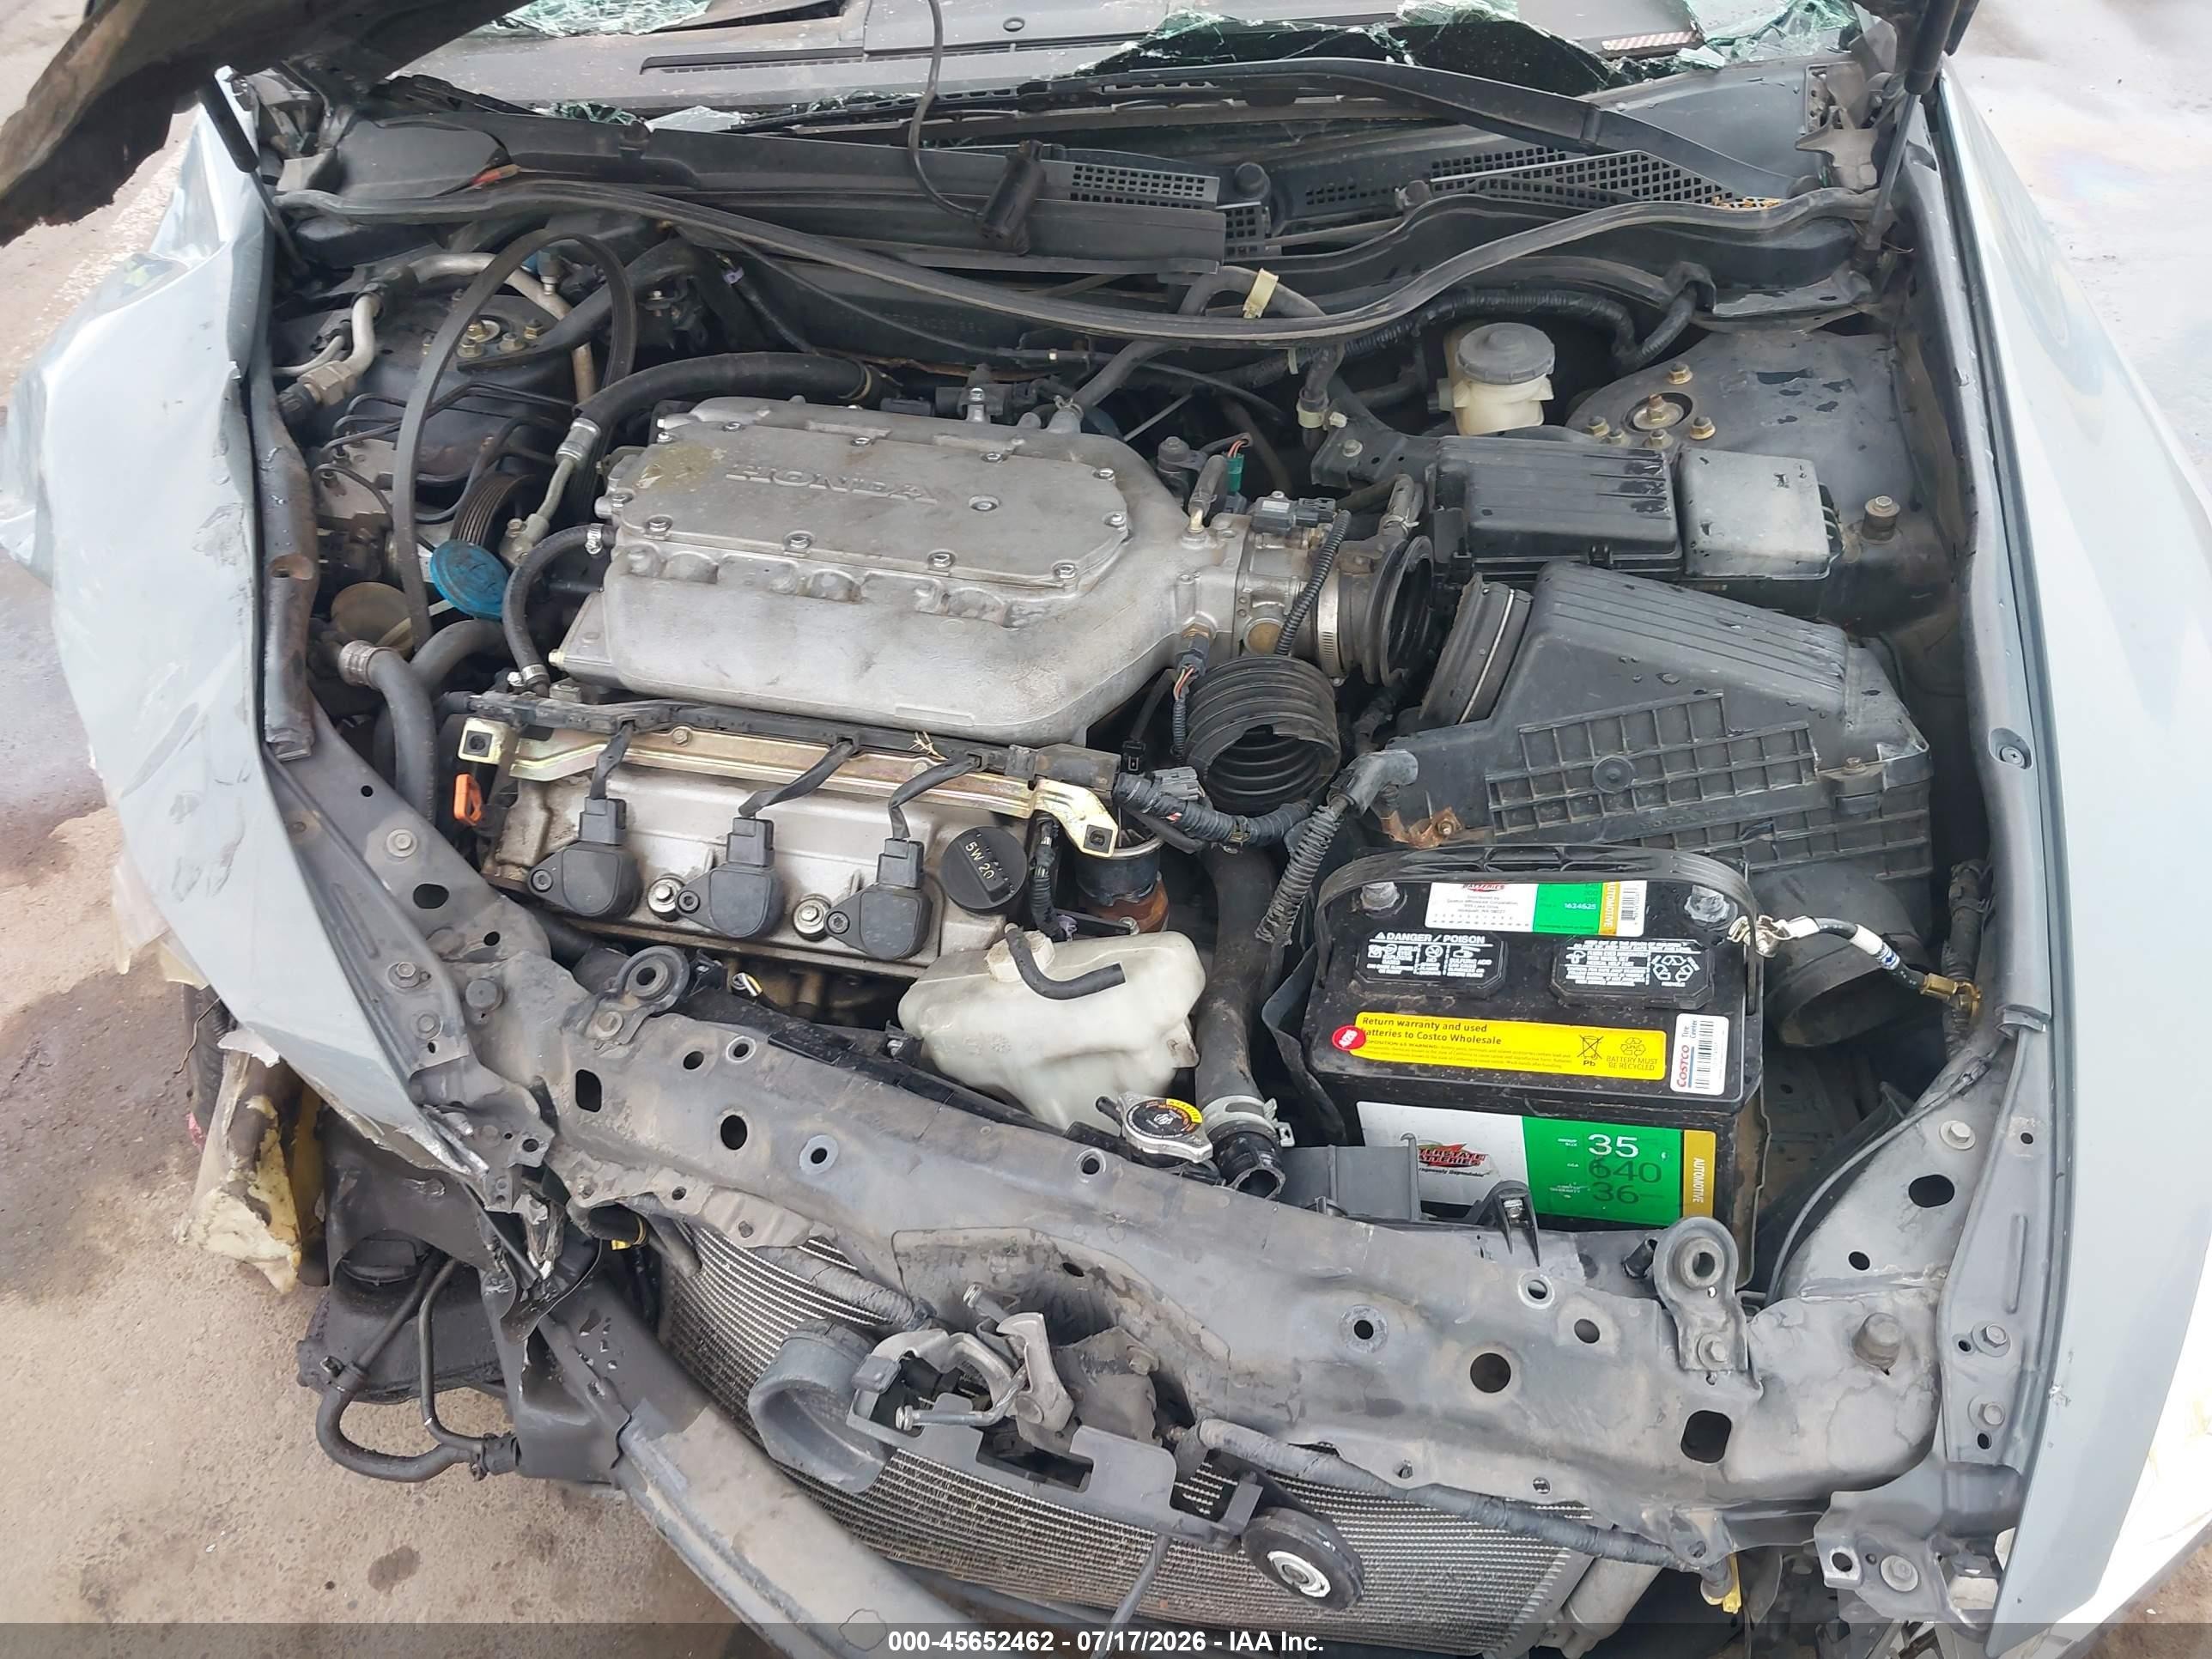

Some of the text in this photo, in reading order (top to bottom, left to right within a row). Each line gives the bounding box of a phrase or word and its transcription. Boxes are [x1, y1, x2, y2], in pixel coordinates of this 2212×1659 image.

[726, 465, 938, 505] HONDA
[1386, 932, 1433, 942] DANGER
[1443, 935, 1486, 944] POISON
[1363, 1017, 1487, 1033] Return warranty and used
[1681, 1025, 1690, 1038] Tire
[1361, 1027, 1502, 1045] atteries to Costco Wholesale
[1607, 1055, 1658, 1066] BATTERY MUST
[1677, 1045, 1689, 1088] COSTCO
[1588, 1133, 1639, 1158] 35
[1418, 1155, 1484, 1167] ATTERIES
[1589, 1158, 1662, 1184] 640
[1692, 1157, 1705, 1203] AUTOMOTIVE
[1592, 1181, 1640, 1204] 36
